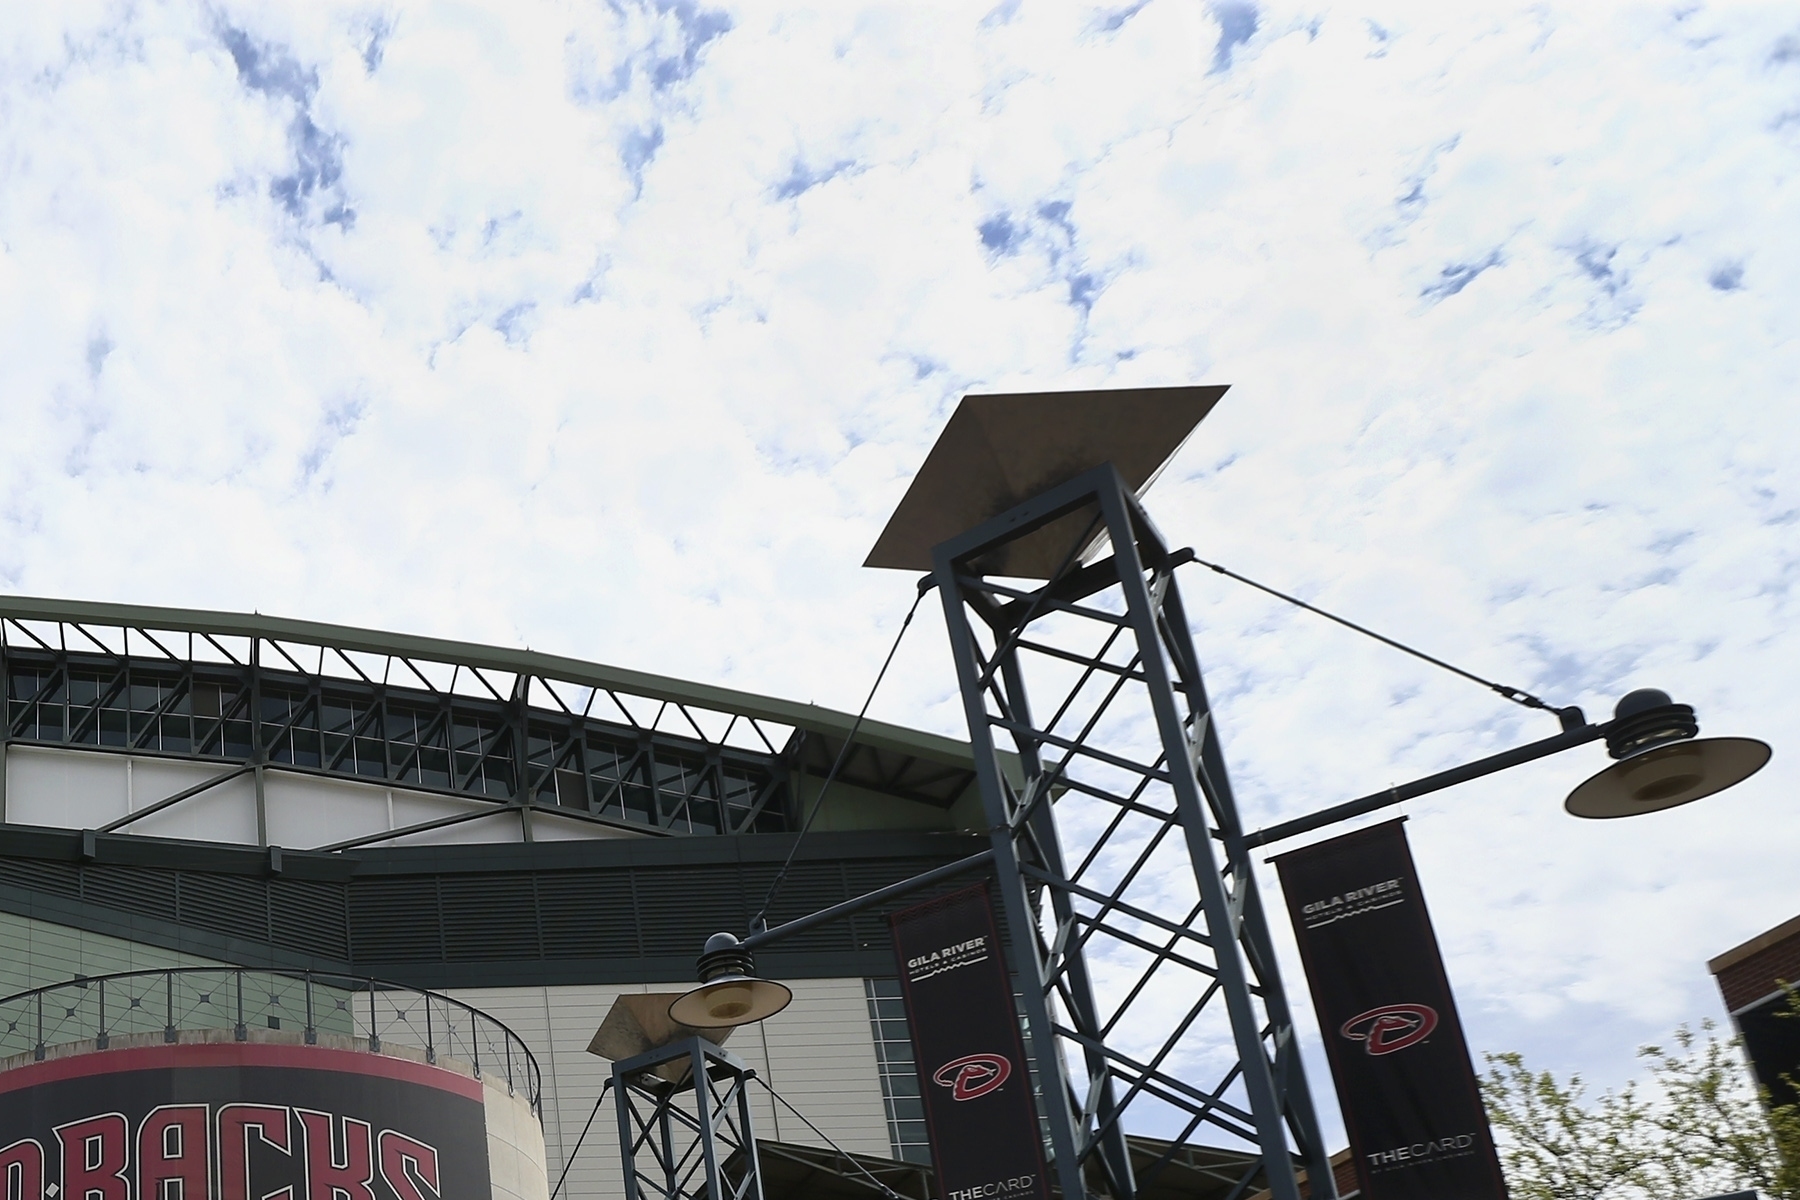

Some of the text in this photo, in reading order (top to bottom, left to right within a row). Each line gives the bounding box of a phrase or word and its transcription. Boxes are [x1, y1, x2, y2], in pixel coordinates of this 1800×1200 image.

[1303, 880, 1400, 914] GILA RIVER
[908, 937, 985, 968] GILA RIVER
